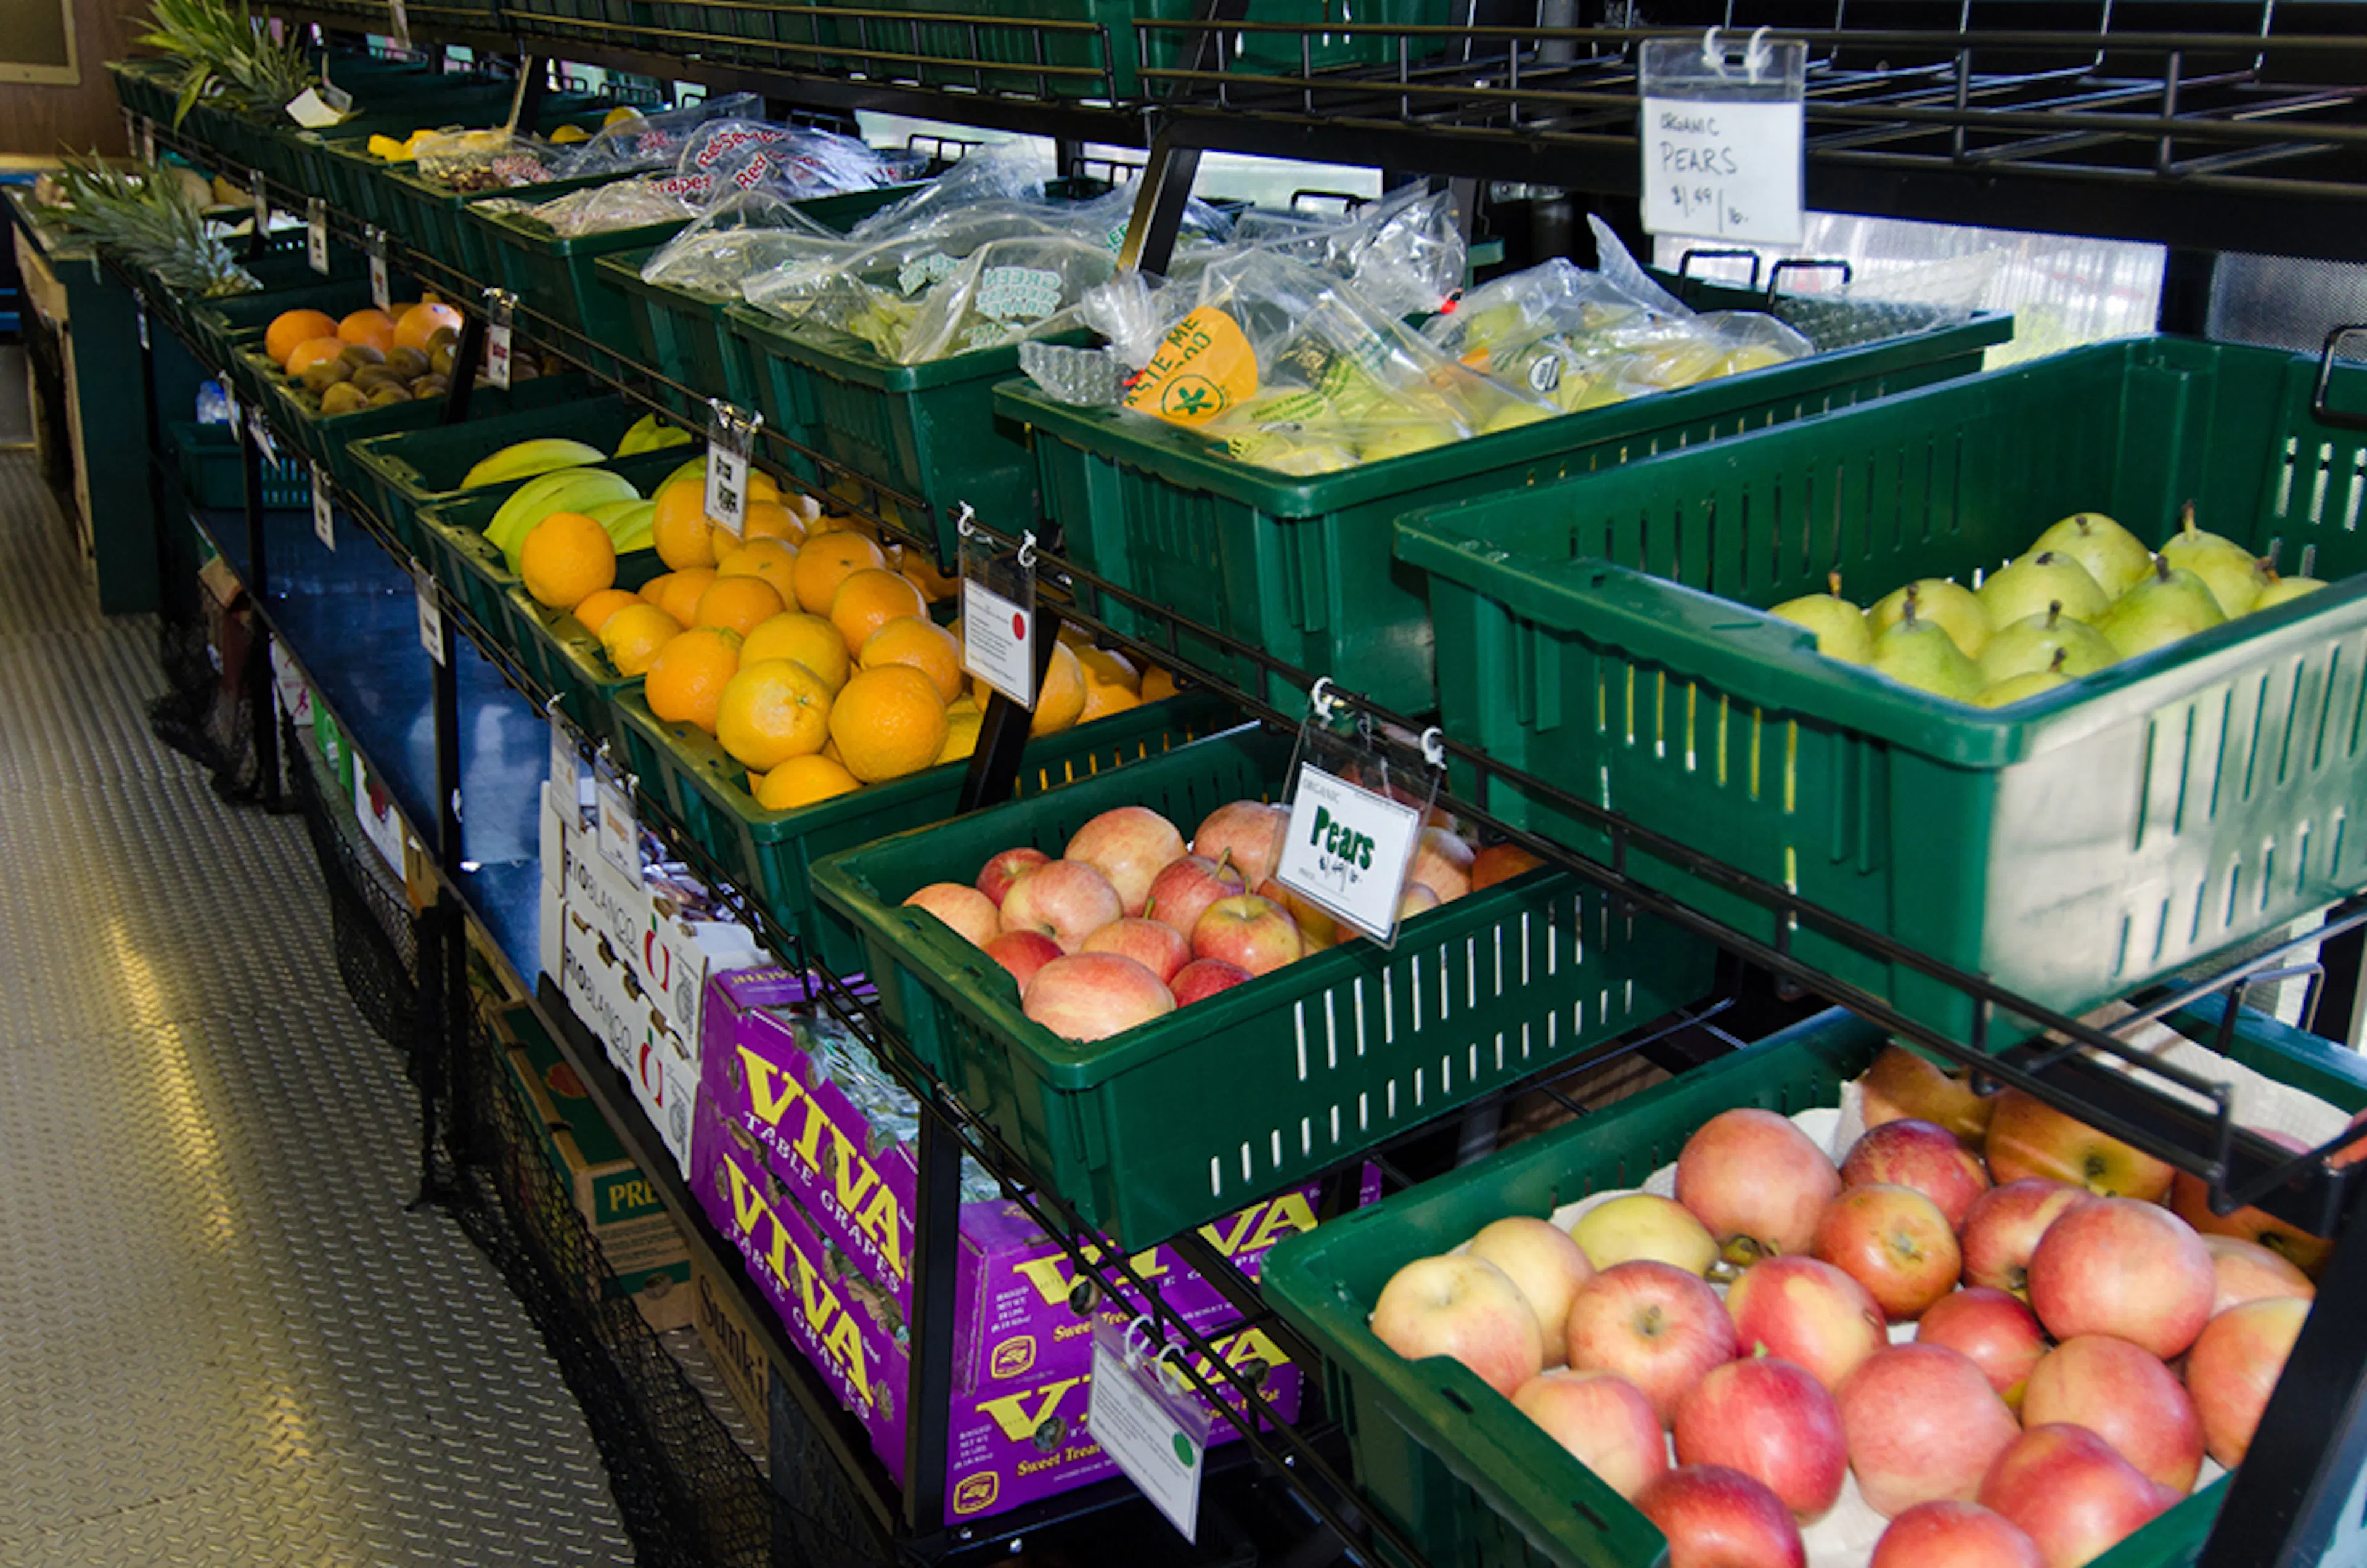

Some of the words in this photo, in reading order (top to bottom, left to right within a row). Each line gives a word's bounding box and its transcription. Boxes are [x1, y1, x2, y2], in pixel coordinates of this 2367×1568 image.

[735, 151, 769, 192] Red
[1659, 141, 1738, 176] PEARS
[1167, 317, 1201, 349] ME
[1309, 804, 1375, 870] Pears
[737, 1043, 906, 1281] VIVA
[743, 1110, 814, 1188] TABLE
[820, 1188, 902, 1294] GRAPES
[724, 1153, 875, 1408] VIVA
[730, 1218, 786, 1302] TABLE
[792, 1305, 870, 1419] GRAPES
[1016, 1453, 1061, 1477] Sweet
